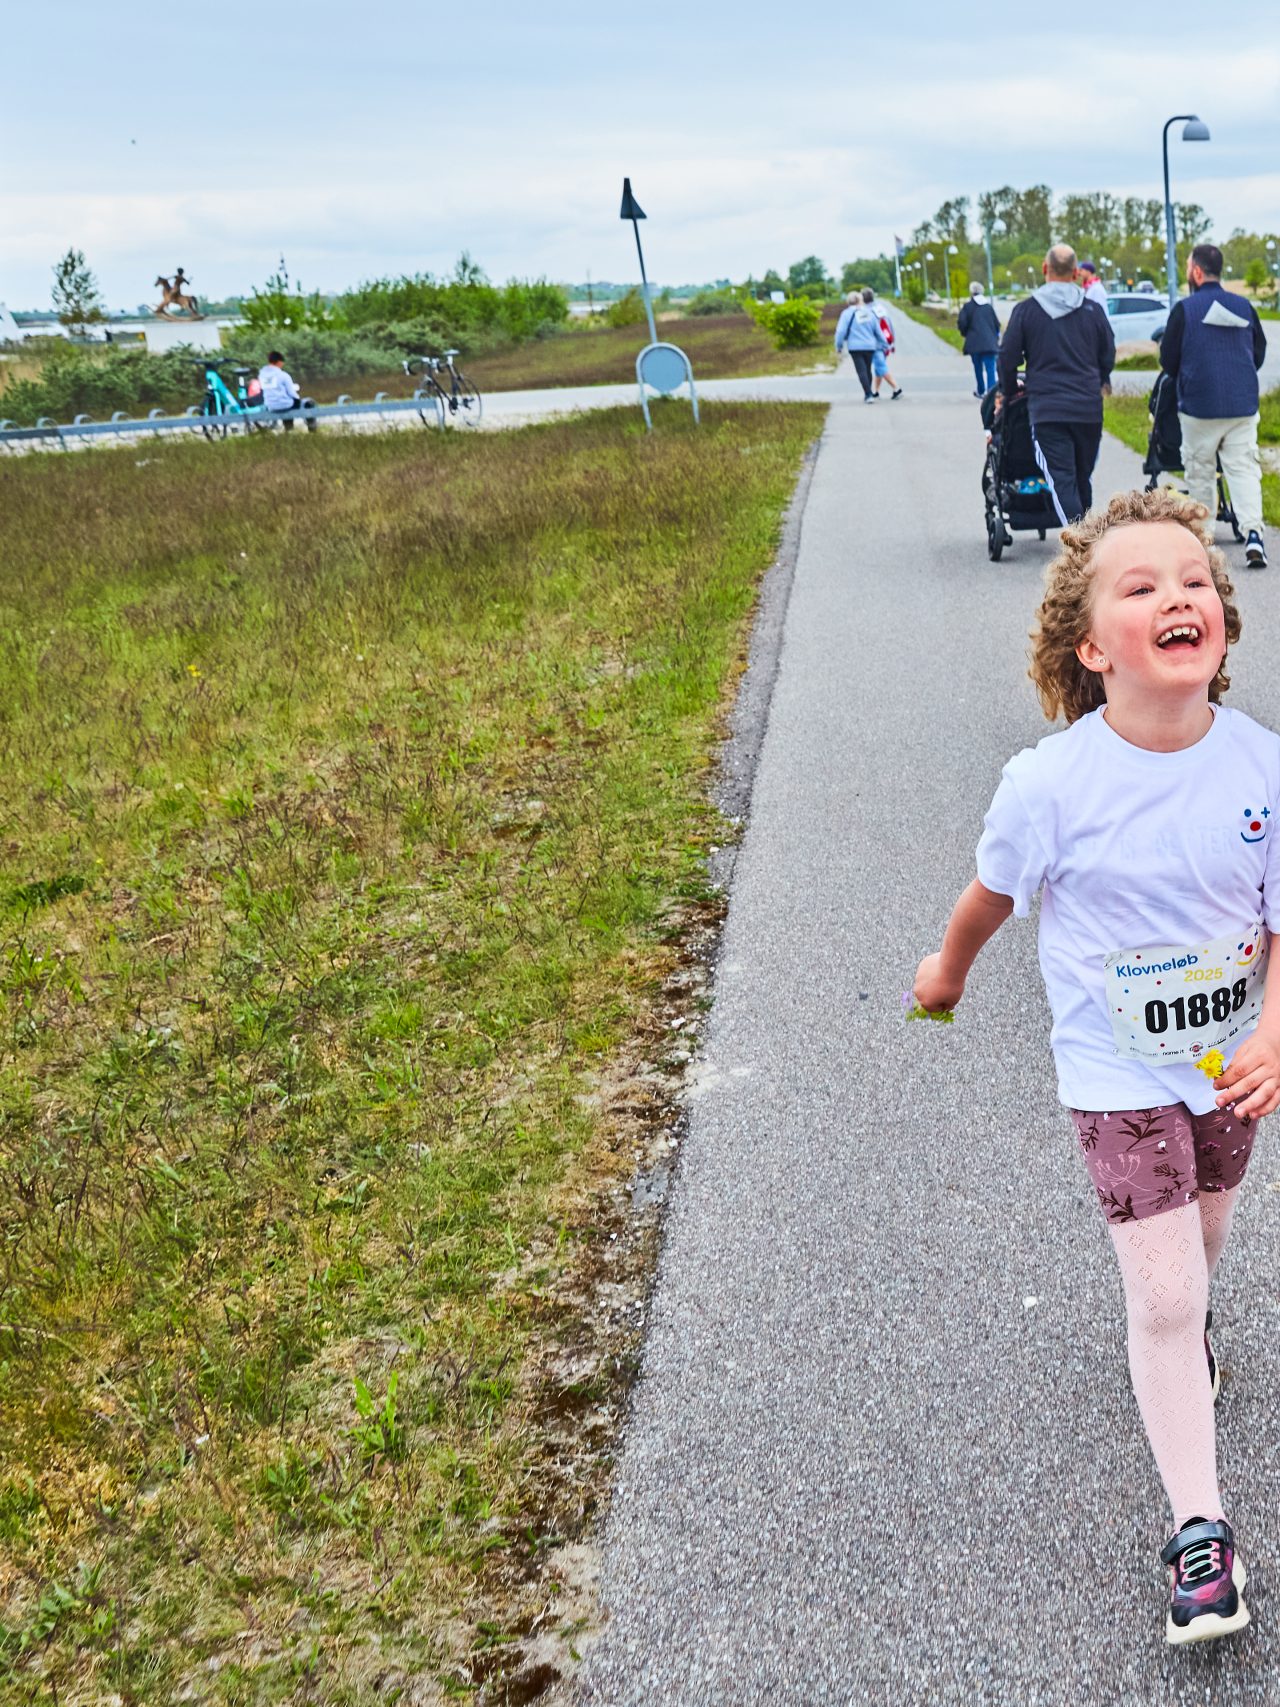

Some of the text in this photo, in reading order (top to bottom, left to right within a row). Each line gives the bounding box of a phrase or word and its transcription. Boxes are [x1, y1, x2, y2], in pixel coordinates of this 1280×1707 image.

[1116, 953, 1199, 978] Klovneløb
[1183, 967, 1223, 983] 2025
[1144, 977, 1248, 1034] 01888
